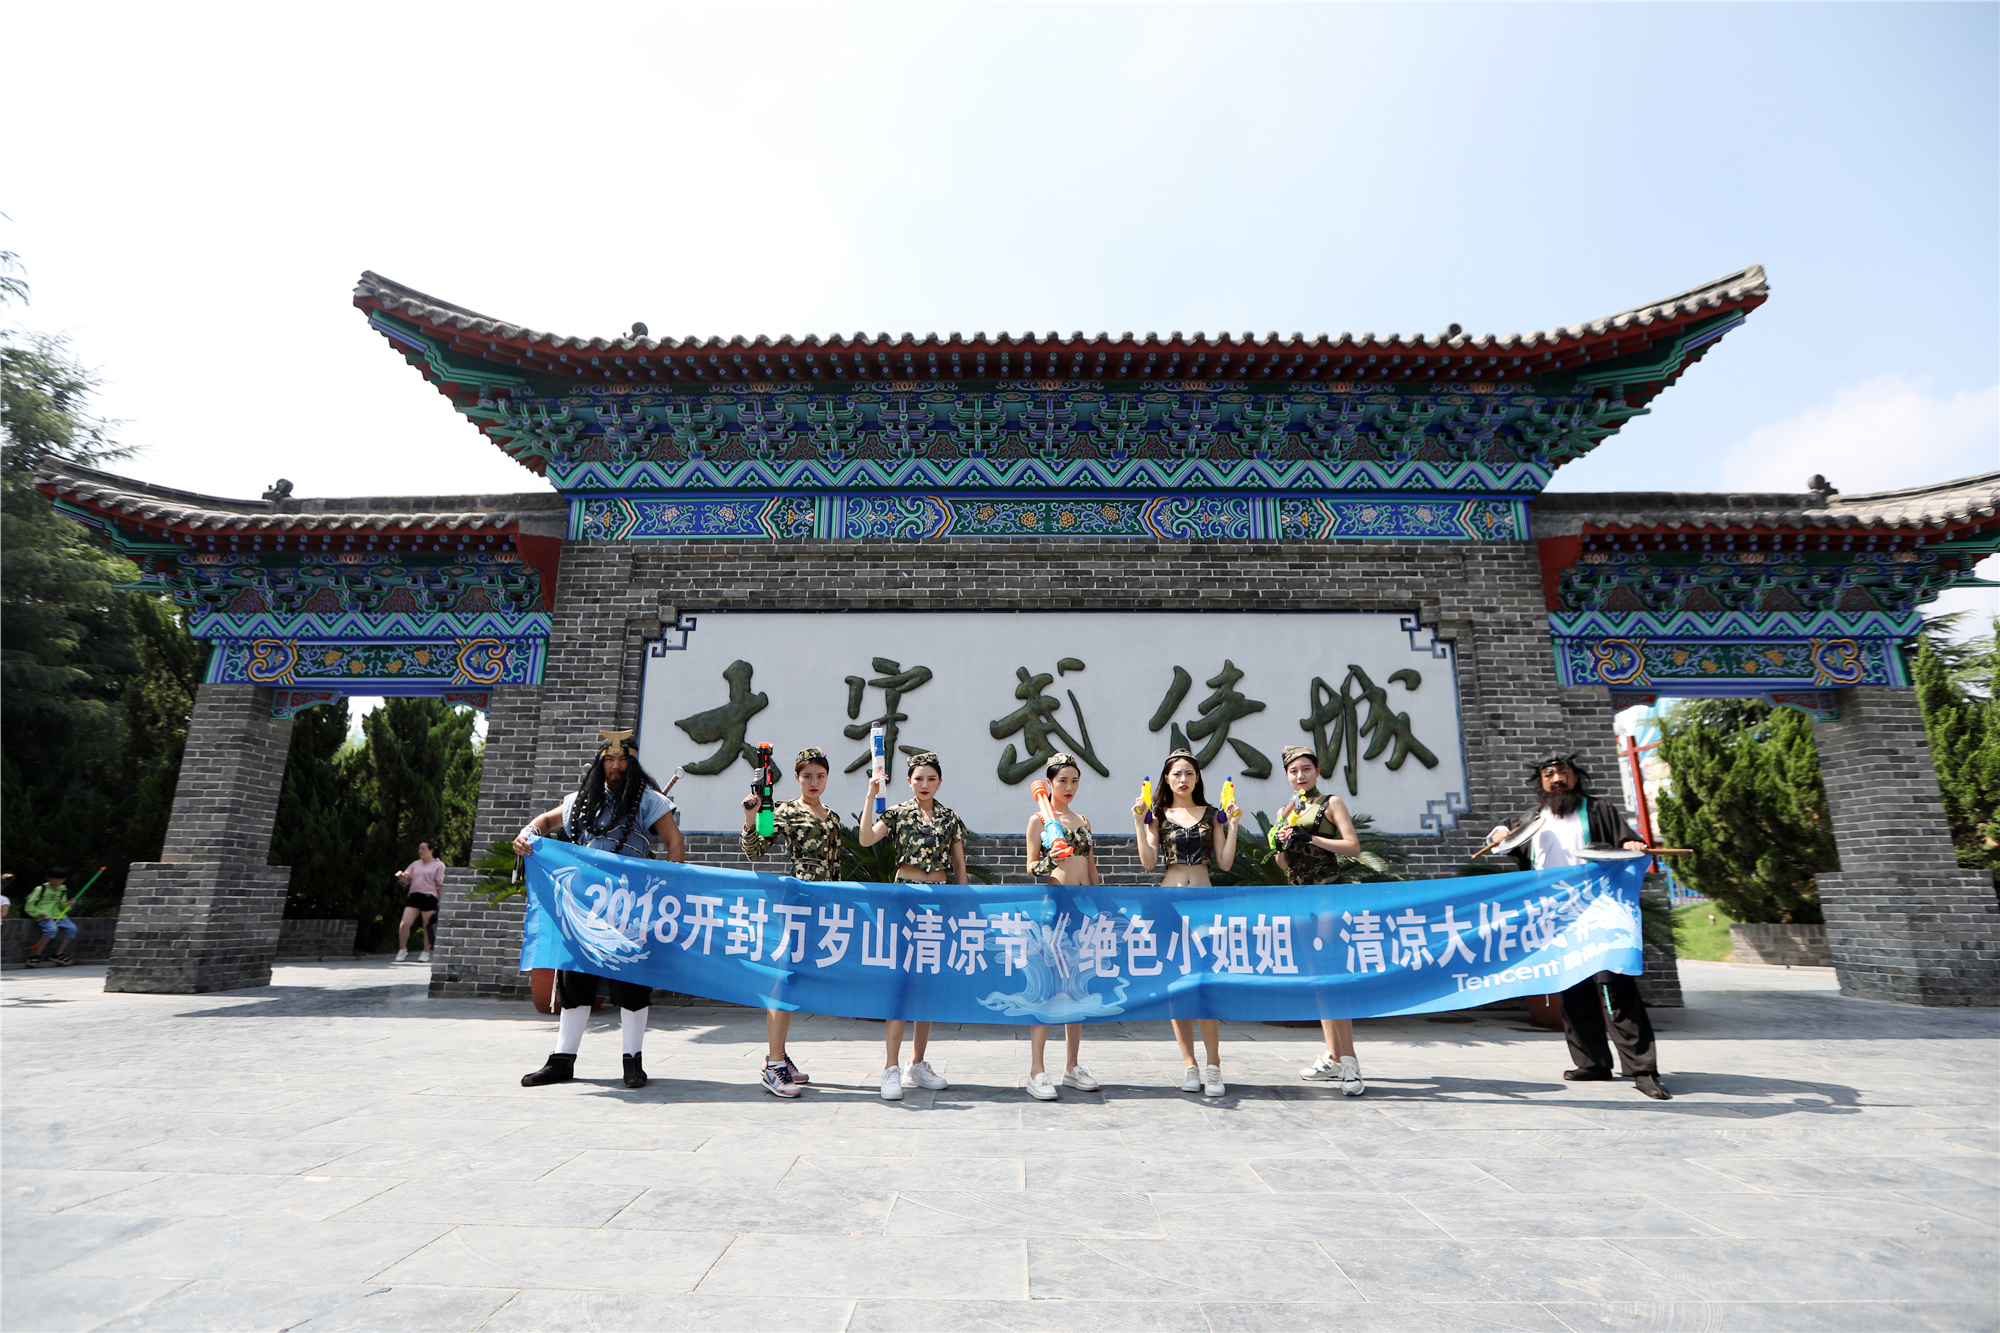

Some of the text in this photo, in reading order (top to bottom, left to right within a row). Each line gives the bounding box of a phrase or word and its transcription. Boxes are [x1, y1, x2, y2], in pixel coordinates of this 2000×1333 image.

[674, 656, 1440, 796] 大宋武侠城
[1452, 959, 1561, 992] Tencent
